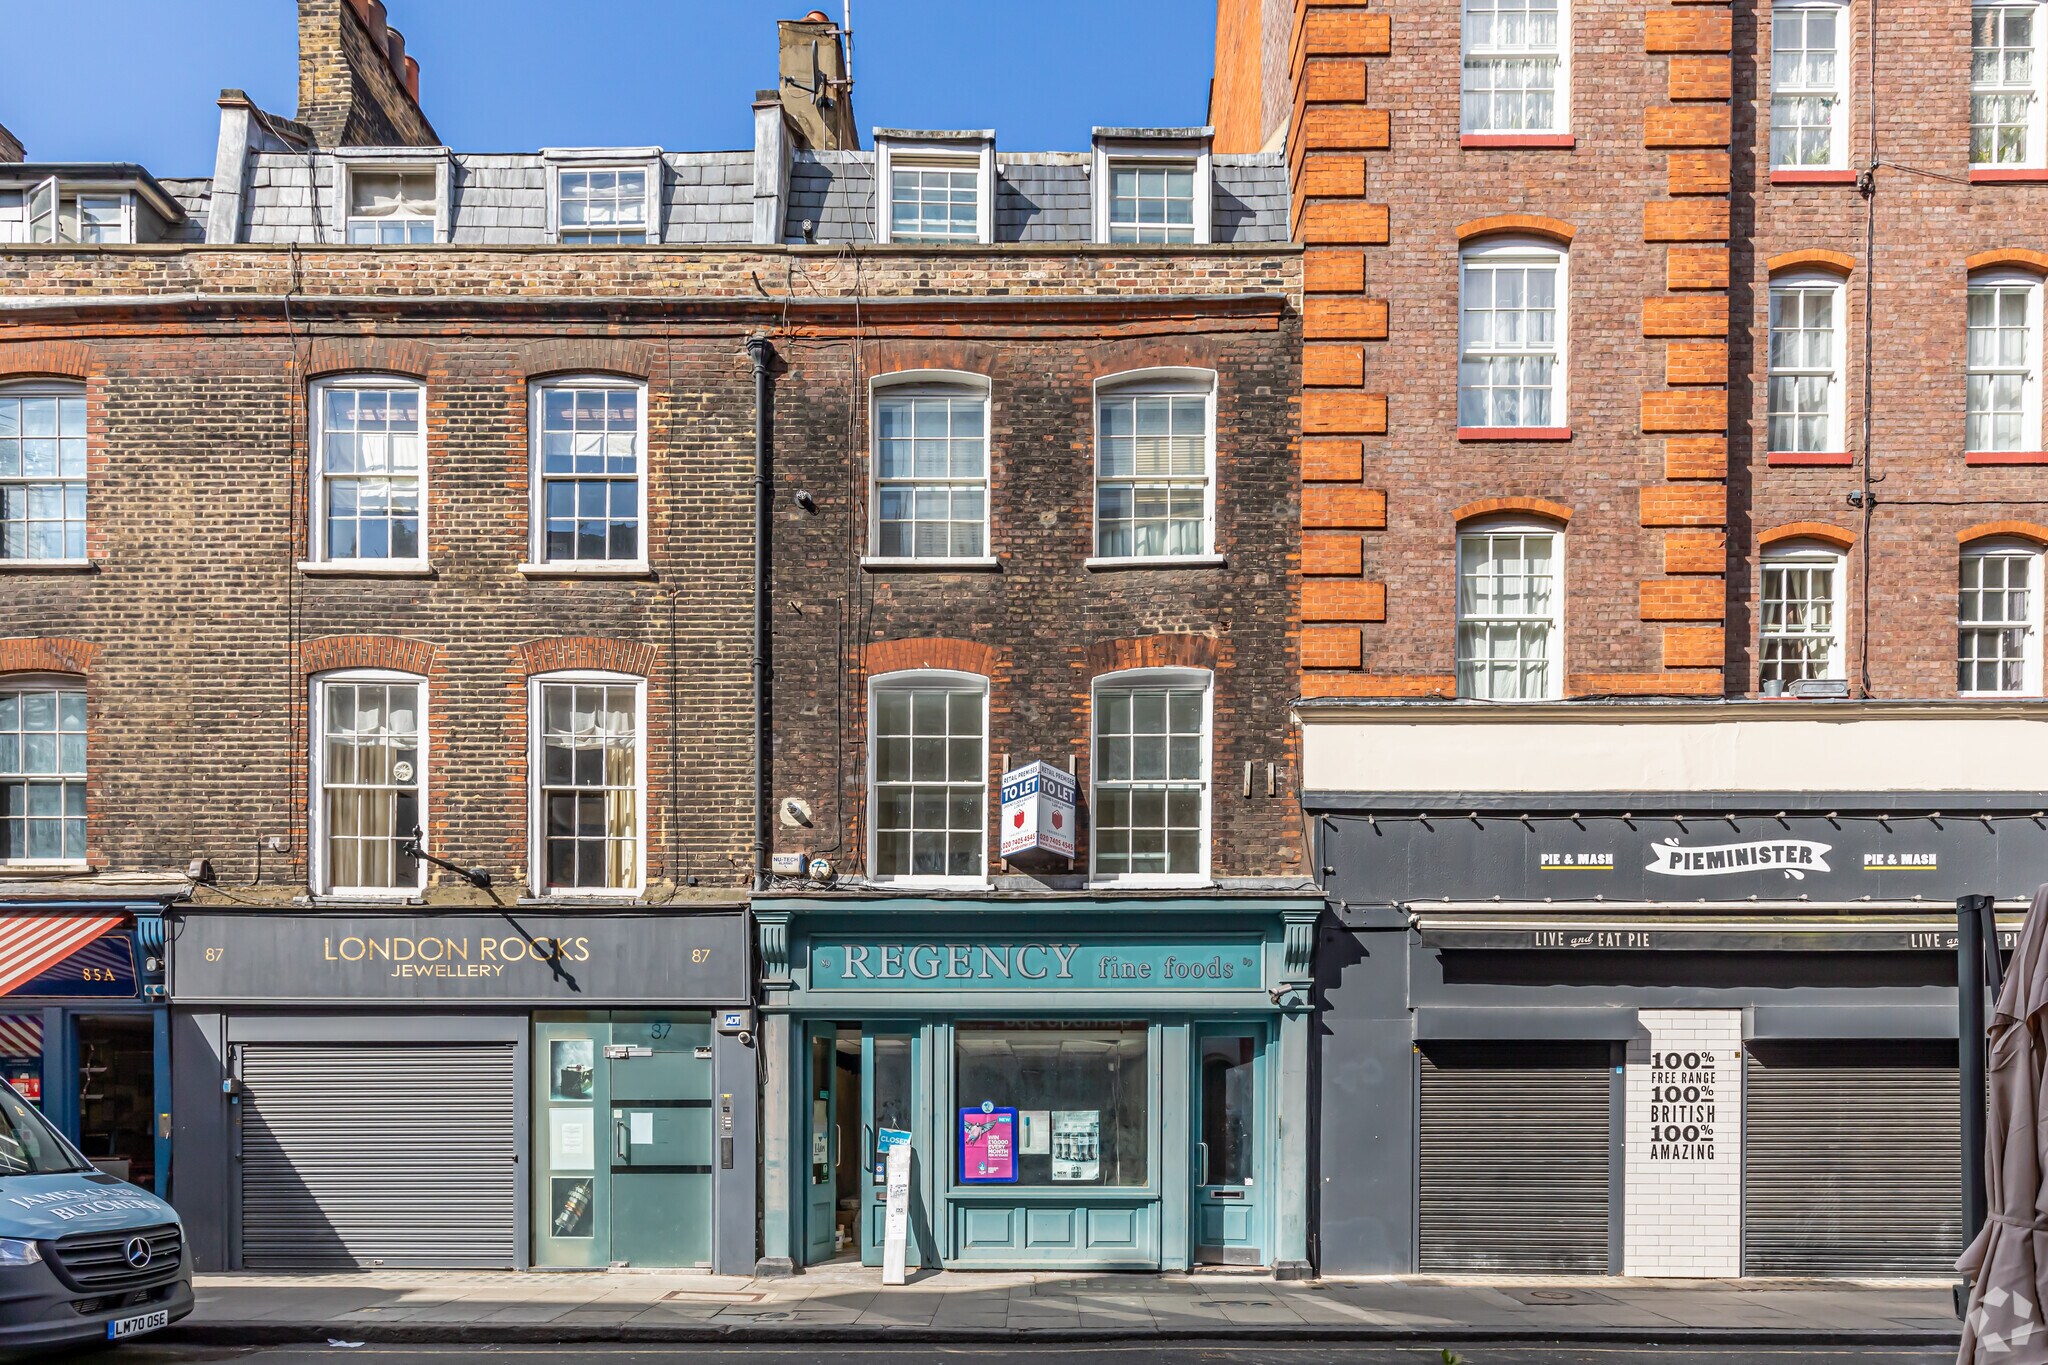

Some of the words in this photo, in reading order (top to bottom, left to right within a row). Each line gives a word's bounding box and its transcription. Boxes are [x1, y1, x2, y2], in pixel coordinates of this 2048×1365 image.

[1004, 774, 1018, 783] RETAIL
[1018, 766, 1037, 777] PREMISES
[1041, 766, 1055, 777] RETAIL
[1055, 772, 1075, 785] PREMISES
[1004, 786, 1018, 801] TO
[1020, 777, 1037, 796] LET
[1041, 778, 1055, 794] TO
[1058, 784, 1074, 802] LET
[1541, 854, 1560, 864] PIE
[1564, 854, 1574, 865] &
[1577, 854, 1613, 864] MASH
[1669, 846, 1812, 870] PIEMINISTER
[1864, 854, 1883, 864] PIE
[1887, 854, 1898, 864] &
[1901, 854, 1936, 864] MASH
[1535, 932, 1564, 946] LIVE
[1570, 932, 1594, 947] and
[1598, 932, 1621, 946] EAT
[1628, 933, 1650, 947] PIE
[1911, 933, 1940, 948] LIVE
[2004, 933, 2017, 947] PI
[205, 947, 224, 962] 87
[324, 937, 467, 961] LONDON
[481, 937, 589, 961] ROCKS
[691, 948, 710, 962] 87
[820, 958, 831, 968] 89
[841, 943, 1081, 979] REGENCY
[1099, 956, 1151, 979] fine
[1164, 956, 1233, 979] foods
[82, 968, 115, 981] 85A
[391, 964, 504, 977] JEWELLERY
[726, 1016, 740, 1025] ADT
[651, 1023, 672, 1040] 87
[1652, 1052, 1715, 1069] 100%
[1651, 1072, 1676, 1083] FREE
[1681, 1072, 1715, 1083] RANGE
[1651, 1086, 1714, 1103] 100%
[1651, 1105, 1715, 1122] BRITISH
[1651, 1125, 1713, 1142] 100%
[1650, 1144, 1714, 1160] AMAZING
[8, 1189, 87, 1209] JAMES
[50, 1200, 161, 1221] BUTCHERS
[116, 1317, 144, 1335] LM70
[147, 1312, 165, 1328] OSE
